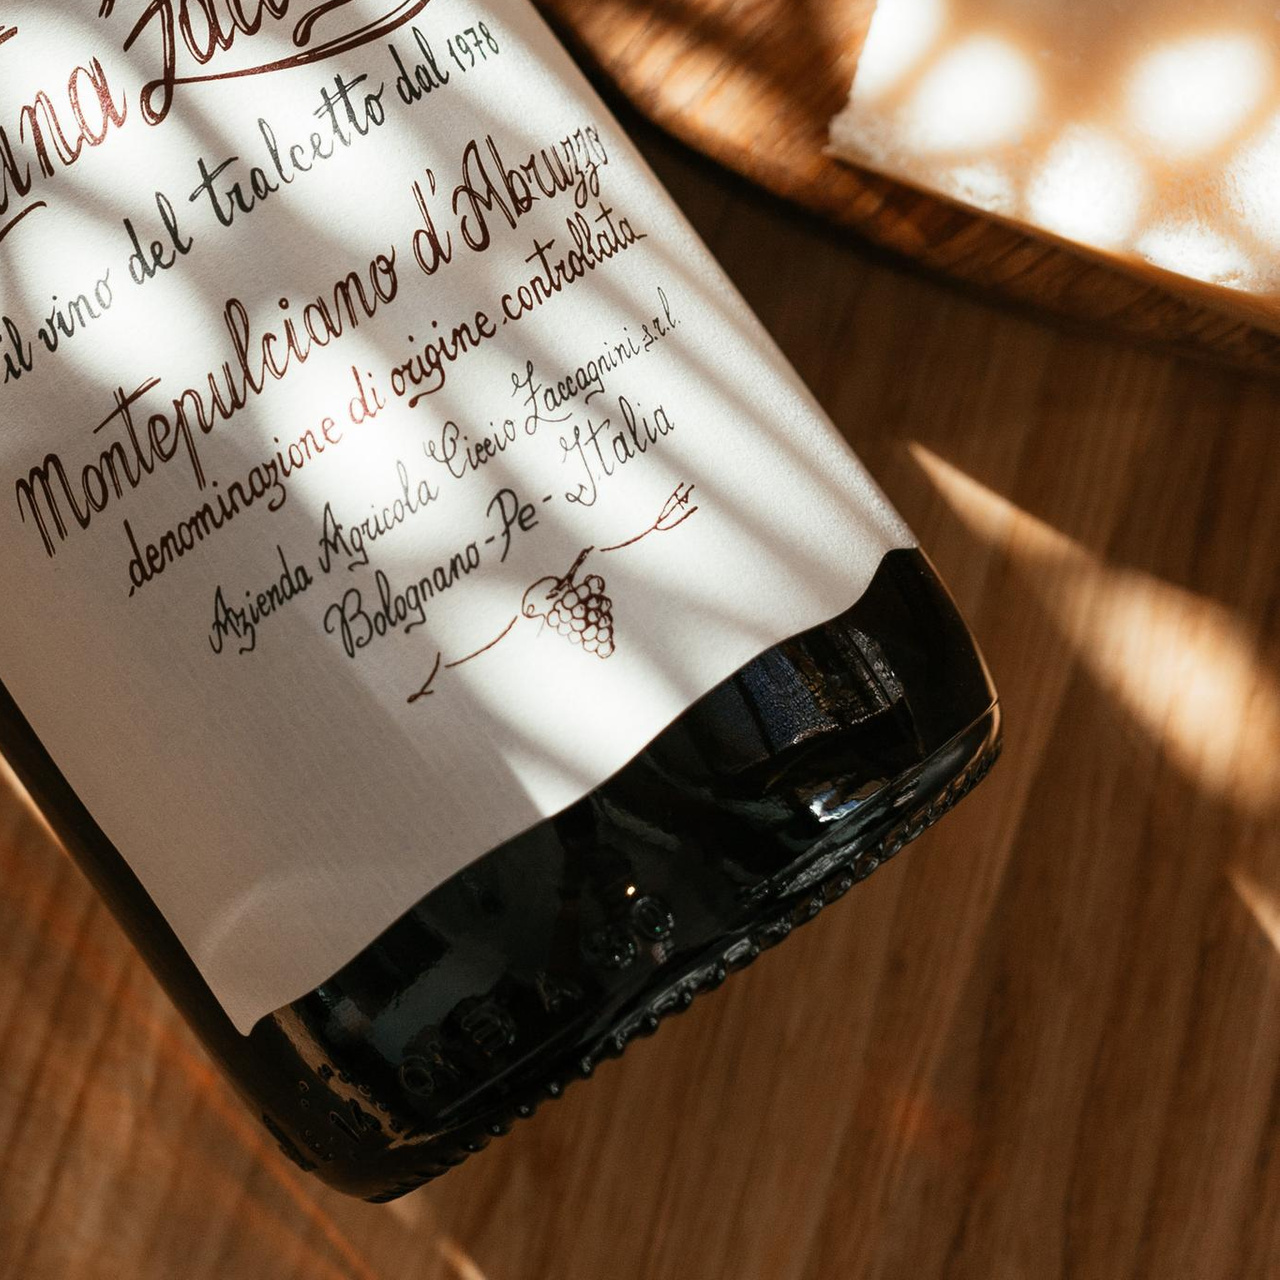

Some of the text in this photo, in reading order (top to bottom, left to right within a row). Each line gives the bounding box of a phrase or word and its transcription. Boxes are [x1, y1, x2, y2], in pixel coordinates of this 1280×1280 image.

[15, 124, 608, 558] Montepulciano d'Abruzzo
[38, 268, 113, 352] vino
[123, 191, 193, 285] del
[188, 73, 385, 227] tralcetto
[396, 26, 450, 105] dal
[447, 20, 500, 72] 1978
[129, 202, 648, 590] denominazione di origine controllata
[209, 545, 314, 655] Azienda
[318, 460, 440, 573] Agricola
[510, 326, 640, 435] Zaccagnini
